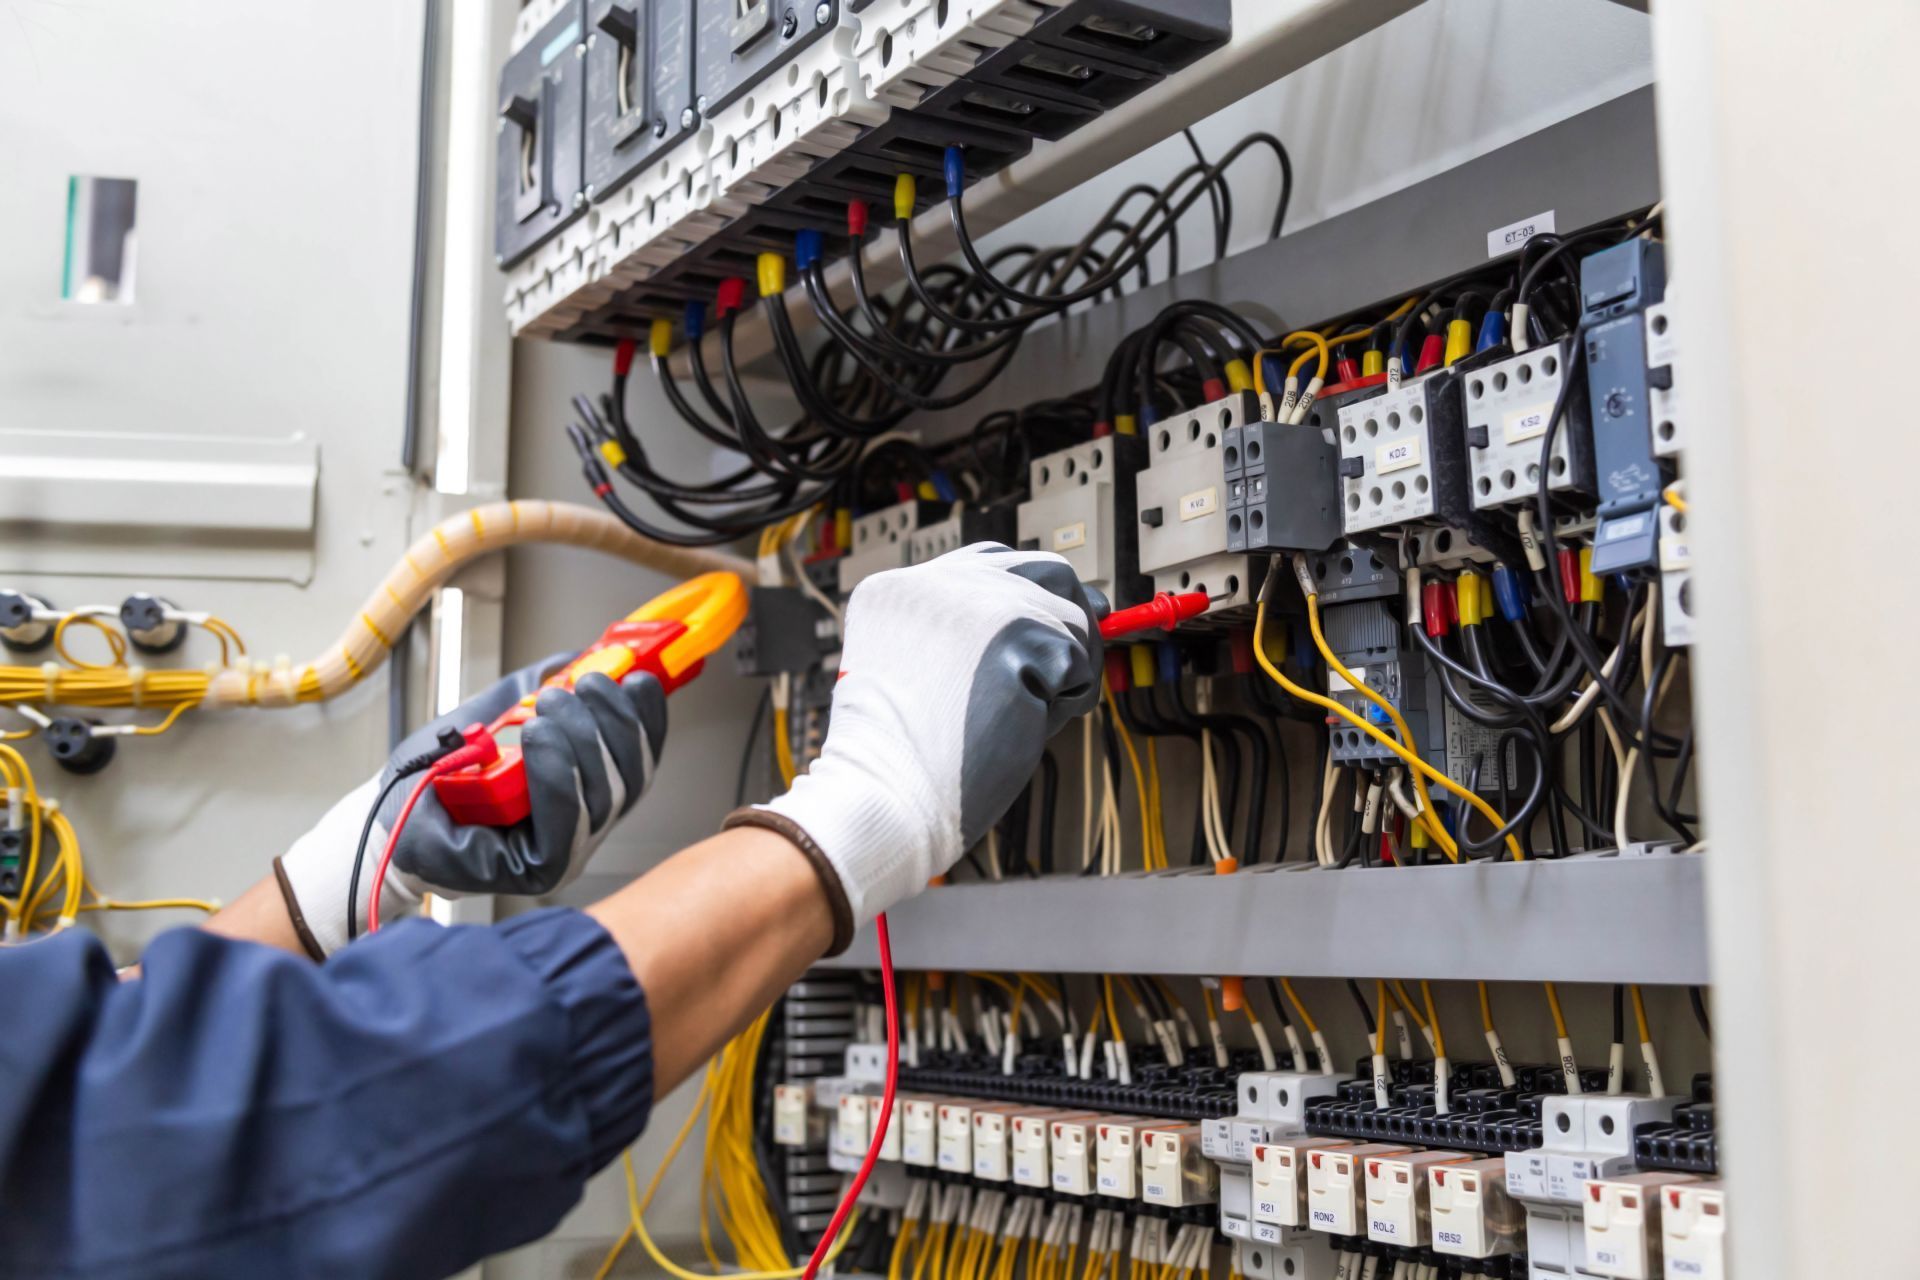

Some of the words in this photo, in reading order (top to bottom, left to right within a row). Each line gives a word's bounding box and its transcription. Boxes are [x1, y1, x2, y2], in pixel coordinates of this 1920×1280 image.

[1504, 225, 1535, 244] CT-03
[1389, 367, 1400, 383] 212
[1520, 415, 1541, 429] KS2
[1389, 446, 1408, 460] KD2
[1190, 497, 1205, 510] KV2
[1563, 1055, 1576, 1076] 208
[1376, 1074, 1386, 1092] 221
[1313, 1211, 1336, 1224] RON2
[1260, 1228, 1274, 1240] 2F2
[1373, 1221, 1396, 1234] ROL2
[1438, 1231, 1463, 1244] RBS2
